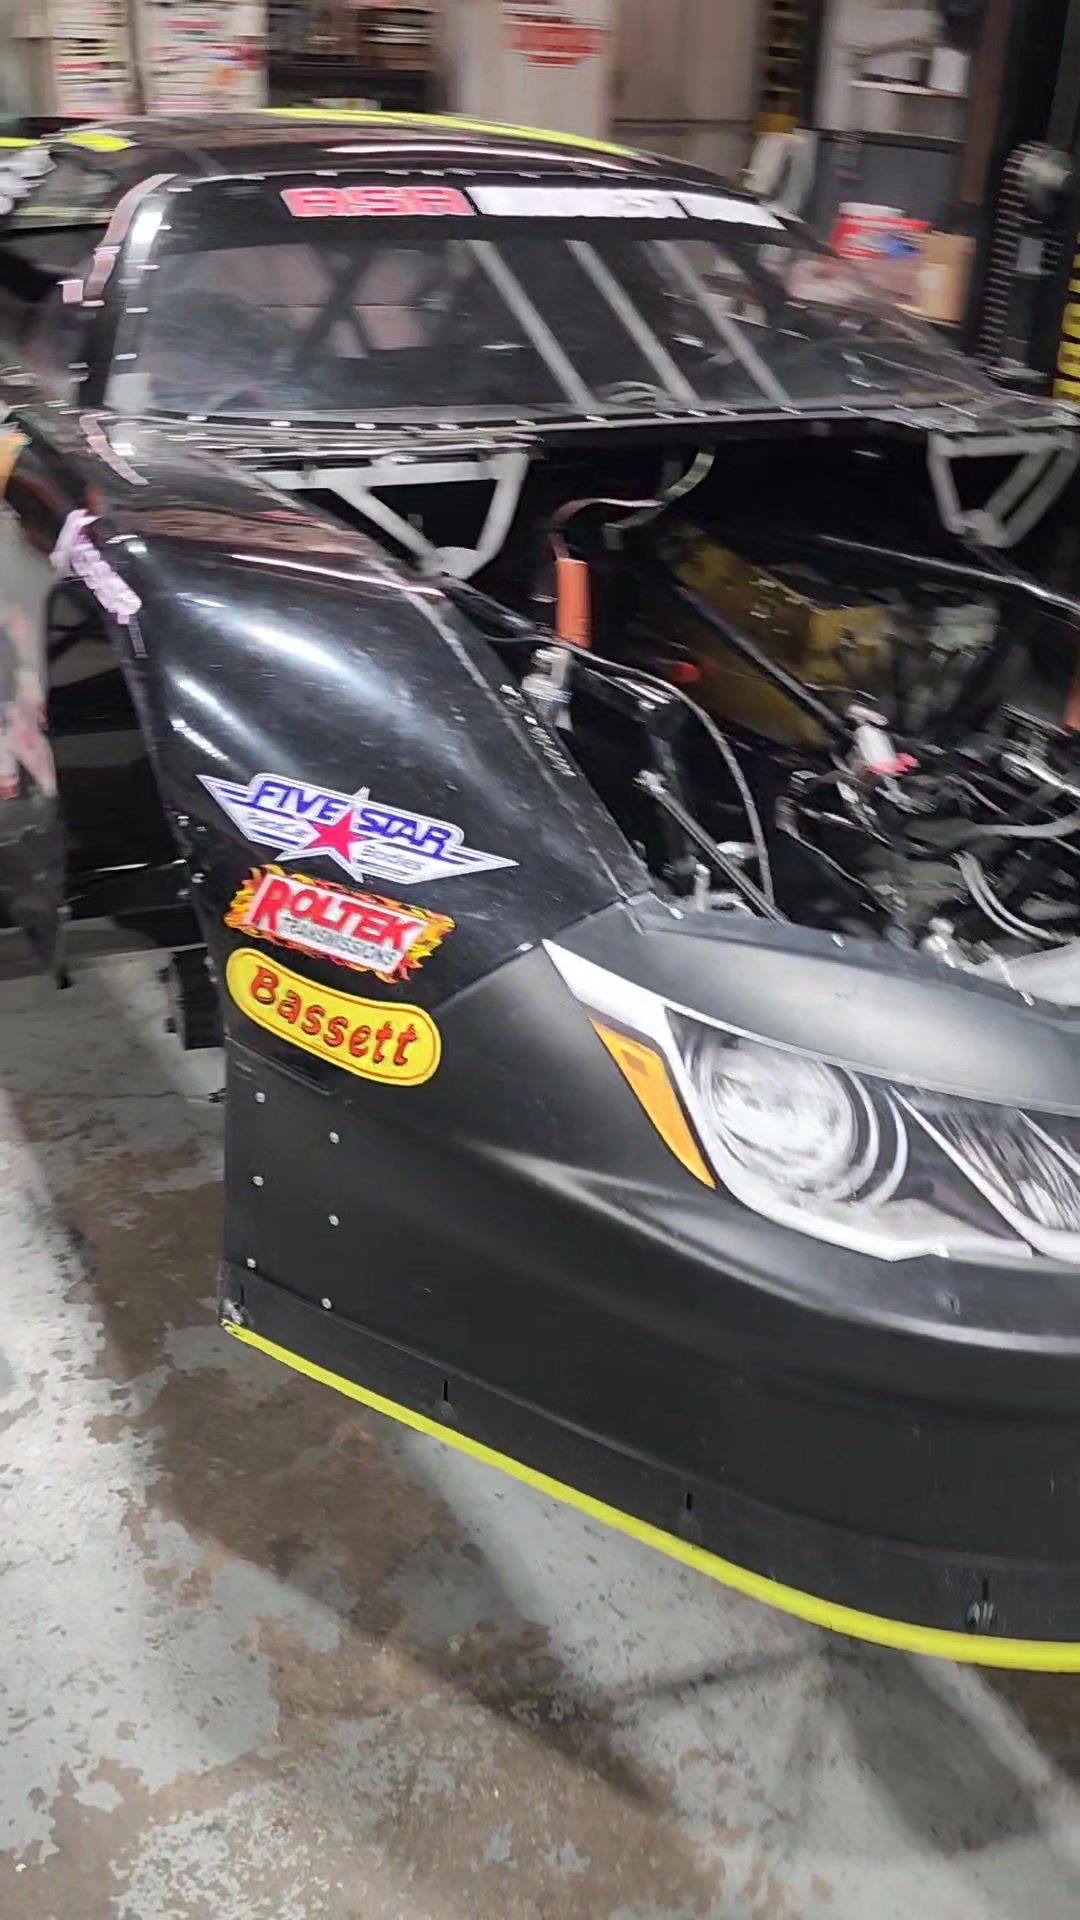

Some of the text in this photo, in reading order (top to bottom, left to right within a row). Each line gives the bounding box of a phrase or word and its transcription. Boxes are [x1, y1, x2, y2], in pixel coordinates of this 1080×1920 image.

[253, 780, 351, 822] FIVE
[356, 808, 452, 858] STAR
[251, 879, 418, 950] ROLTEK
[250, 965, 417, 1066] Bassett
